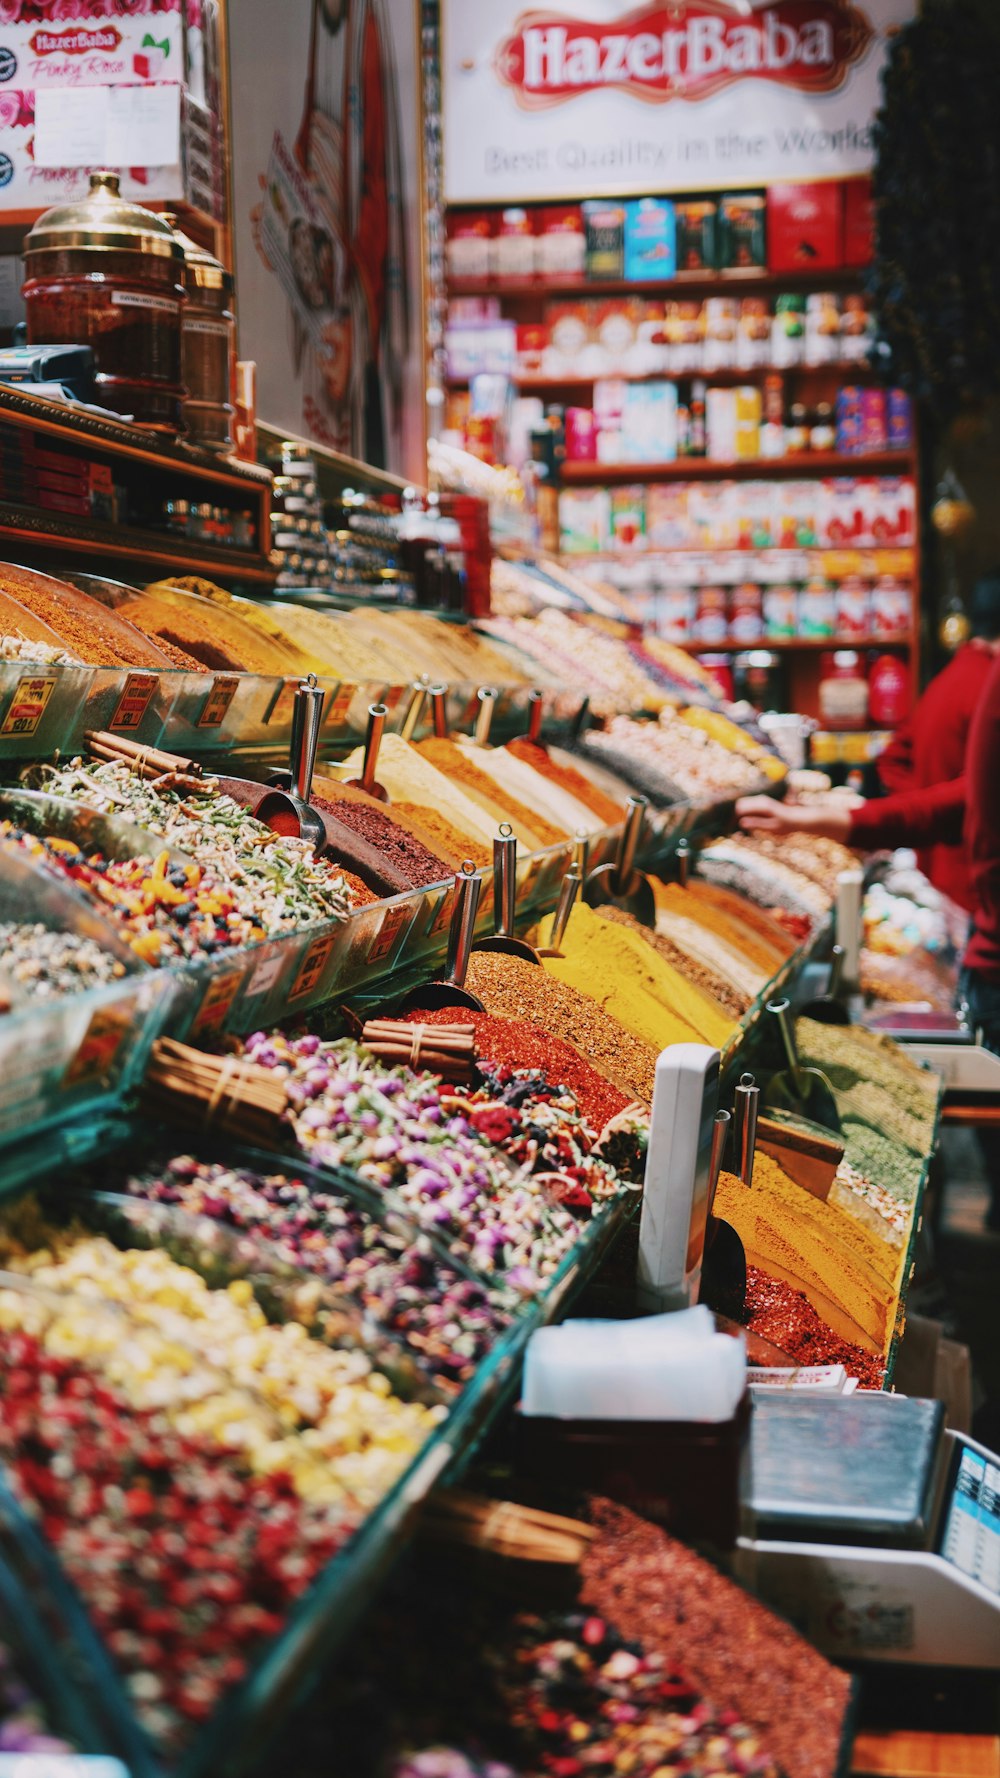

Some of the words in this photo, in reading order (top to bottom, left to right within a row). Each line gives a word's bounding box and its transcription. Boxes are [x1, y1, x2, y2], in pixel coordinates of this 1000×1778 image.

[36, 32, 116, 50] HazerBaba
[522, 11, 833, 87] HazerBaba
[28, 57, 82, 84] Pinky
[83, 55, 126, 74] Rose
[486, 145, 549, 176] Best
[557, 137, 667, 173] Quality
[677, 133, 708, 162] in
[716, 133, 766, 160] the
